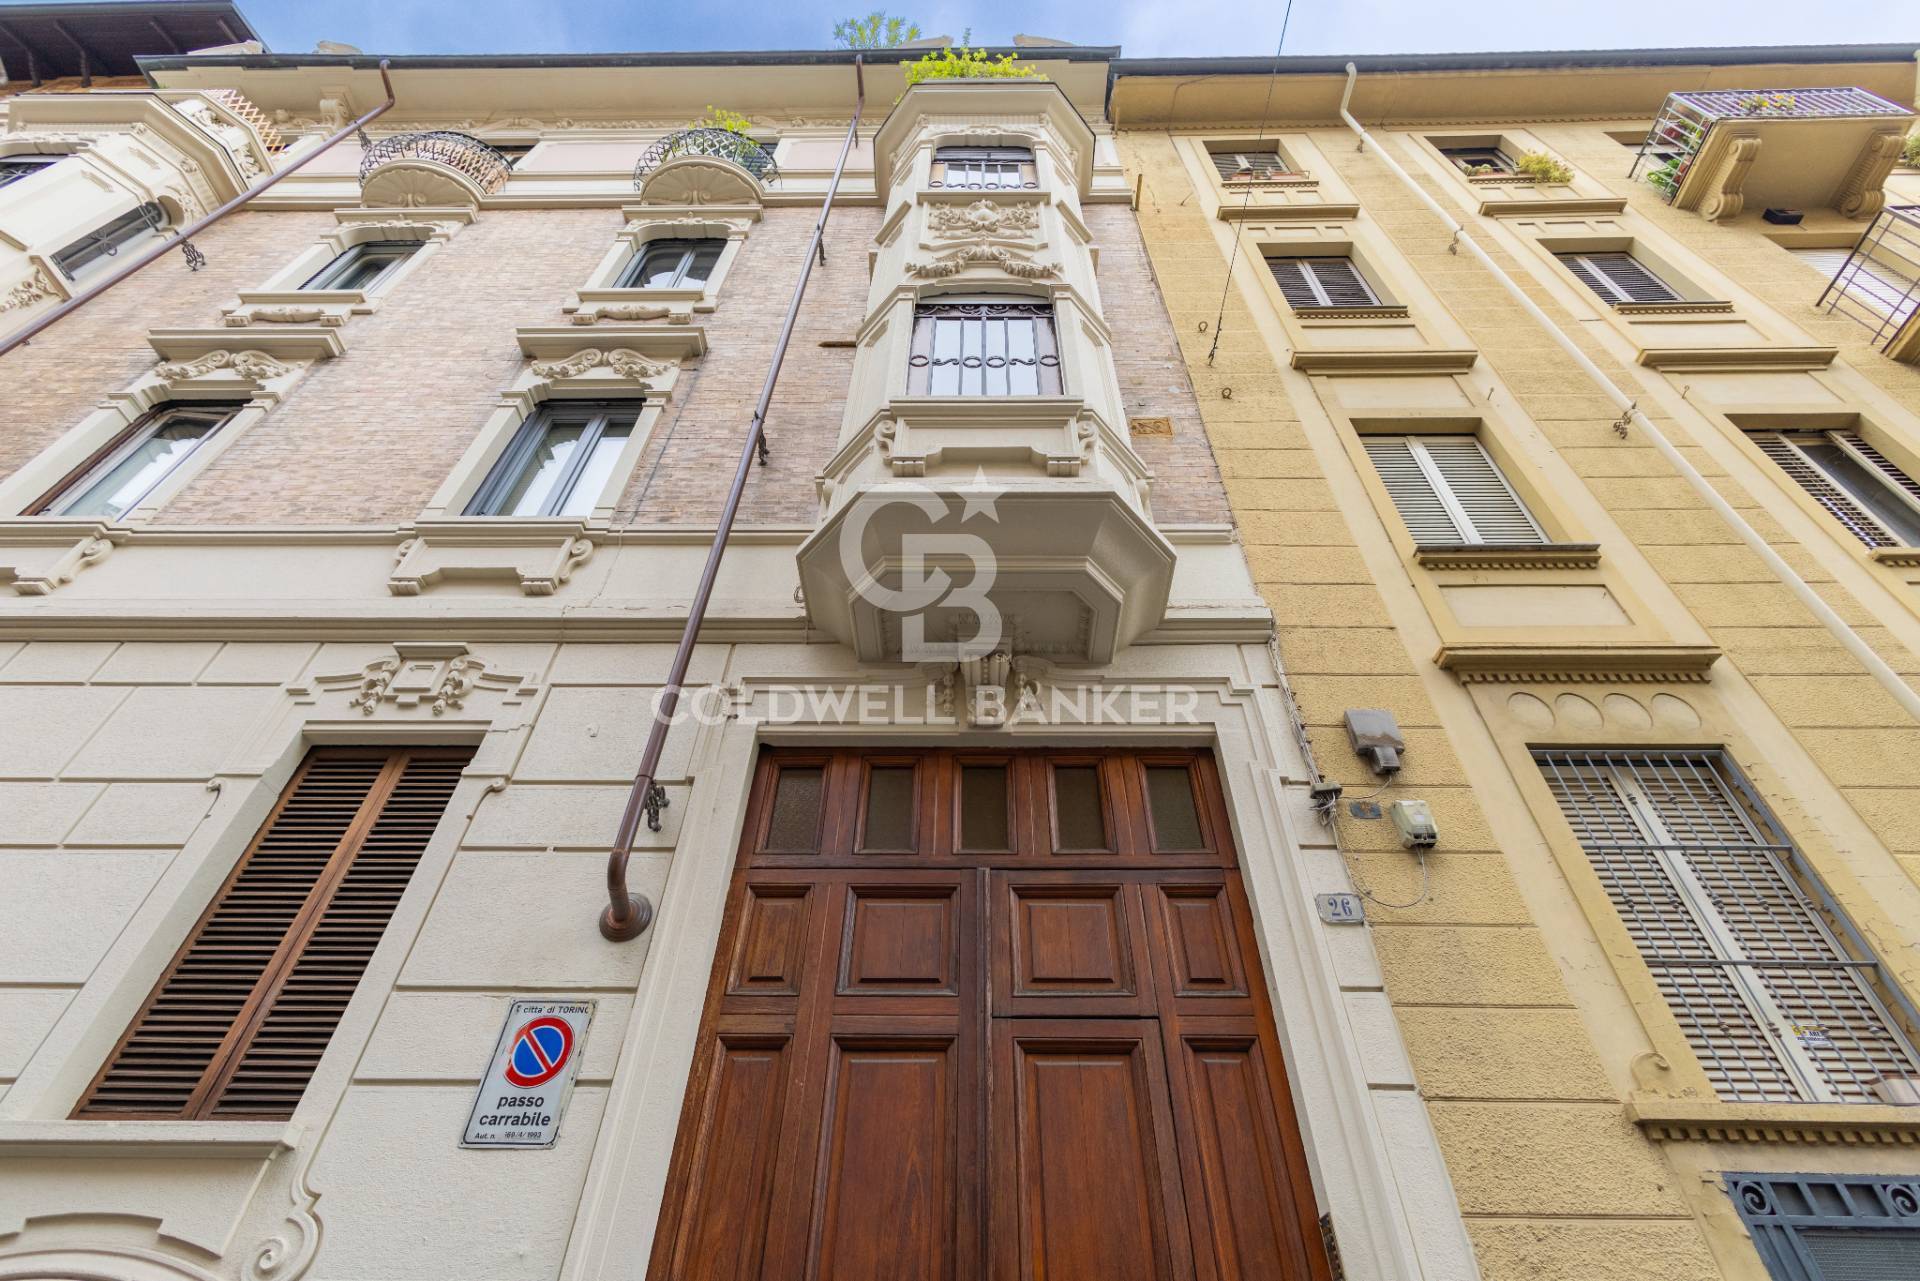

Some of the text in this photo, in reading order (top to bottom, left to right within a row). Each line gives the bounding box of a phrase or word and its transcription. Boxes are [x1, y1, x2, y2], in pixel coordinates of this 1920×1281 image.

[1328, 897, 1353, 917] 26
[547, 1005, 556, 1014] di
[497, 1096, 545, 1110] passo
[479, 1111, 551, 1126] carrabile
